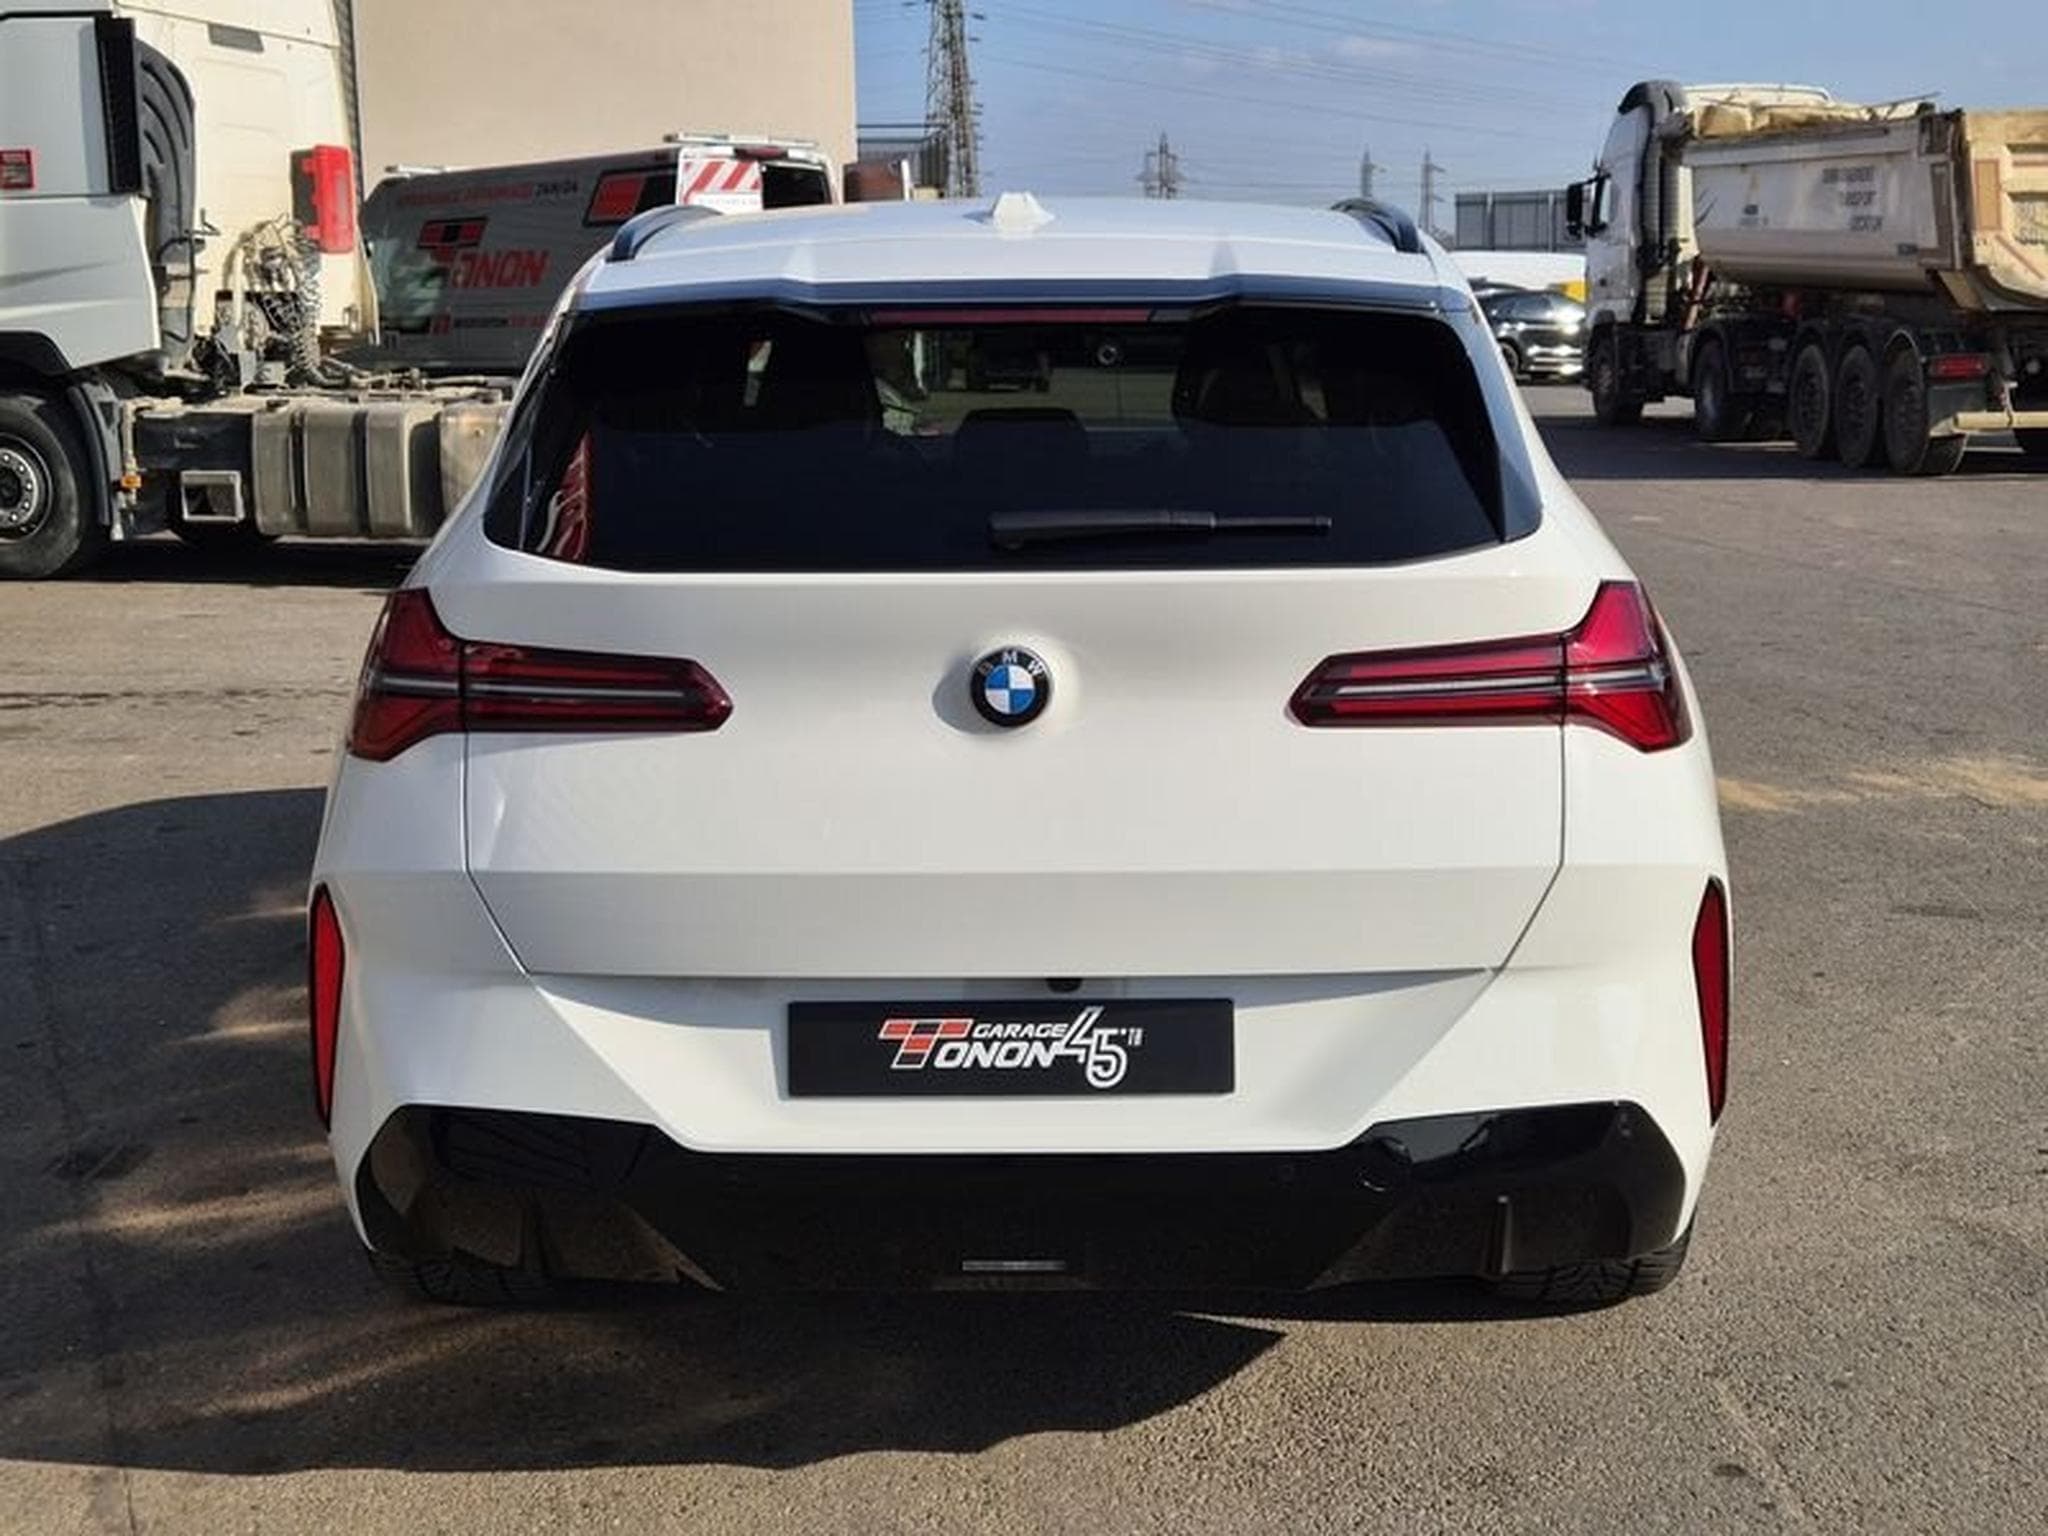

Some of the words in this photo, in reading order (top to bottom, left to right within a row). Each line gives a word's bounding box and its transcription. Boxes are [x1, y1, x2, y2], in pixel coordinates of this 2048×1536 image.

[977, 650, 1044, 676] BMW
[878, 1018, 1063, 1069] TONON
[972, 1023, 1069, 1038] GARAGE
